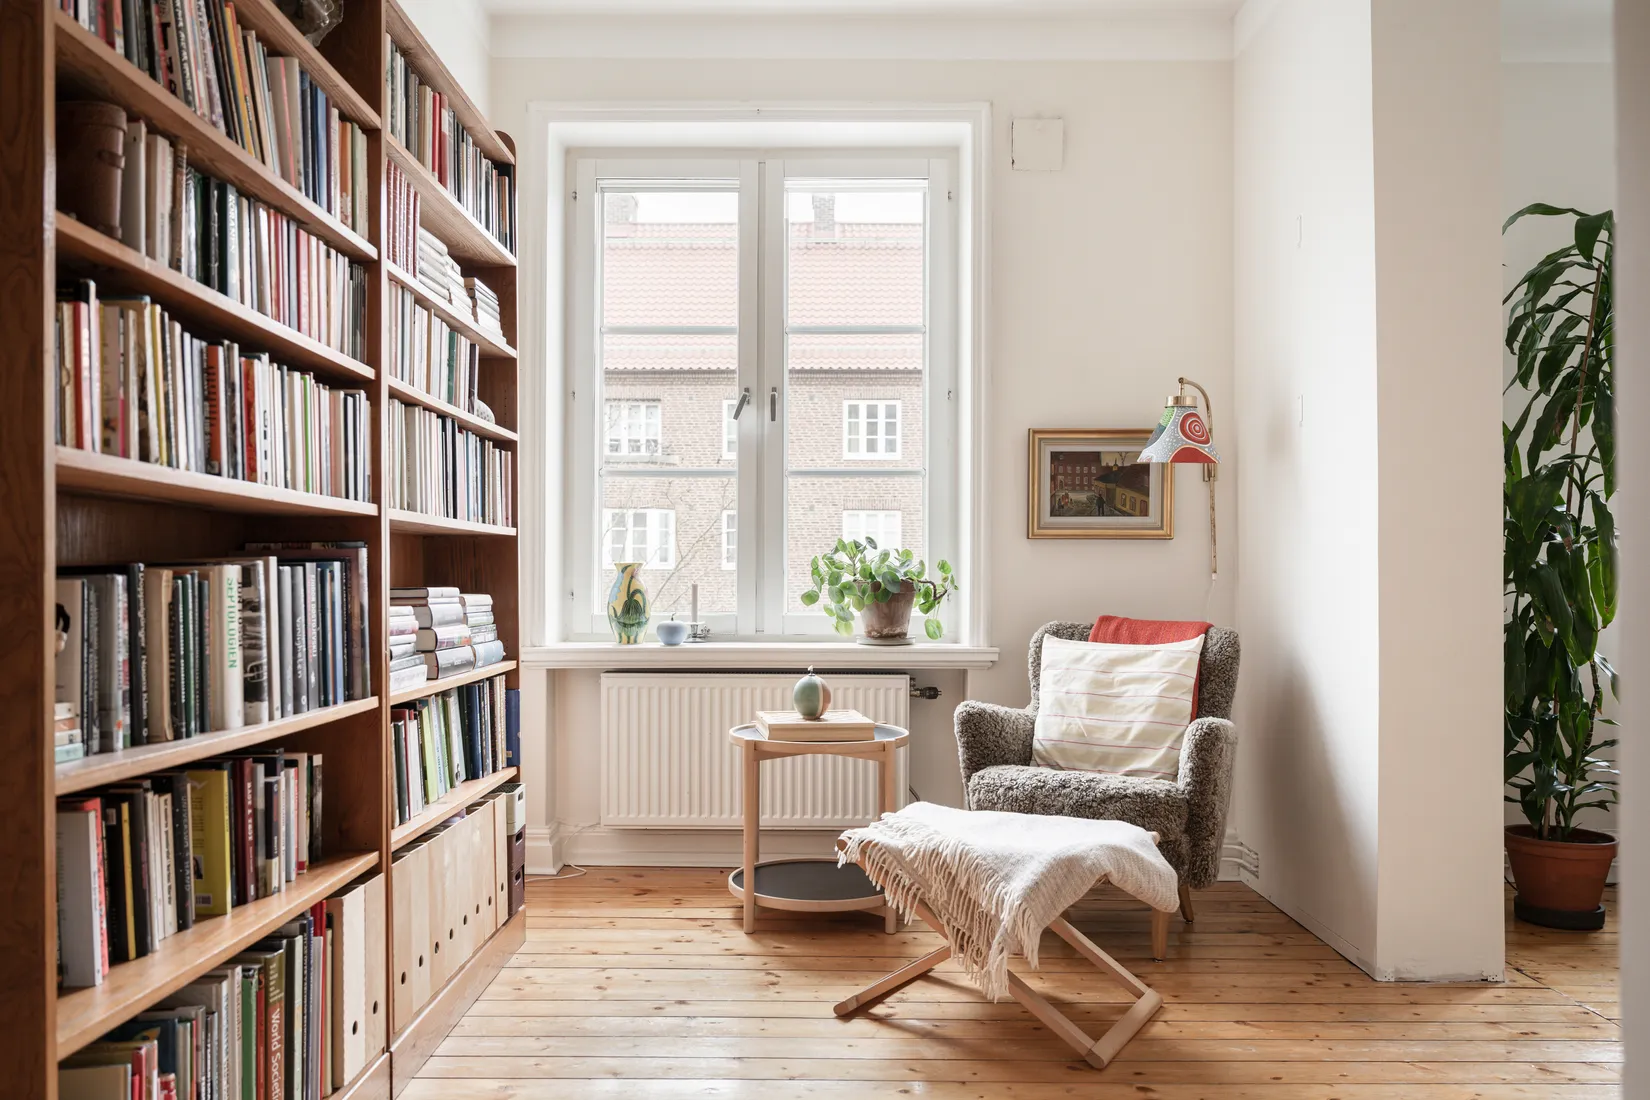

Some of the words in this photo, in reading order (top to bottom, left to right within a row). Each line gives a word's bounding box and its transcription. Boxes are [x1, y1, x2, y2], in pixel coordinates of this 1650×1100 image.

[228, 193, 237, 254] KORANEN
[226, 577, 238, 669] SEPTOLOGIEN
[271, 1008, 281, 1052] World
[271, 1052, 281, 1100] Societi
